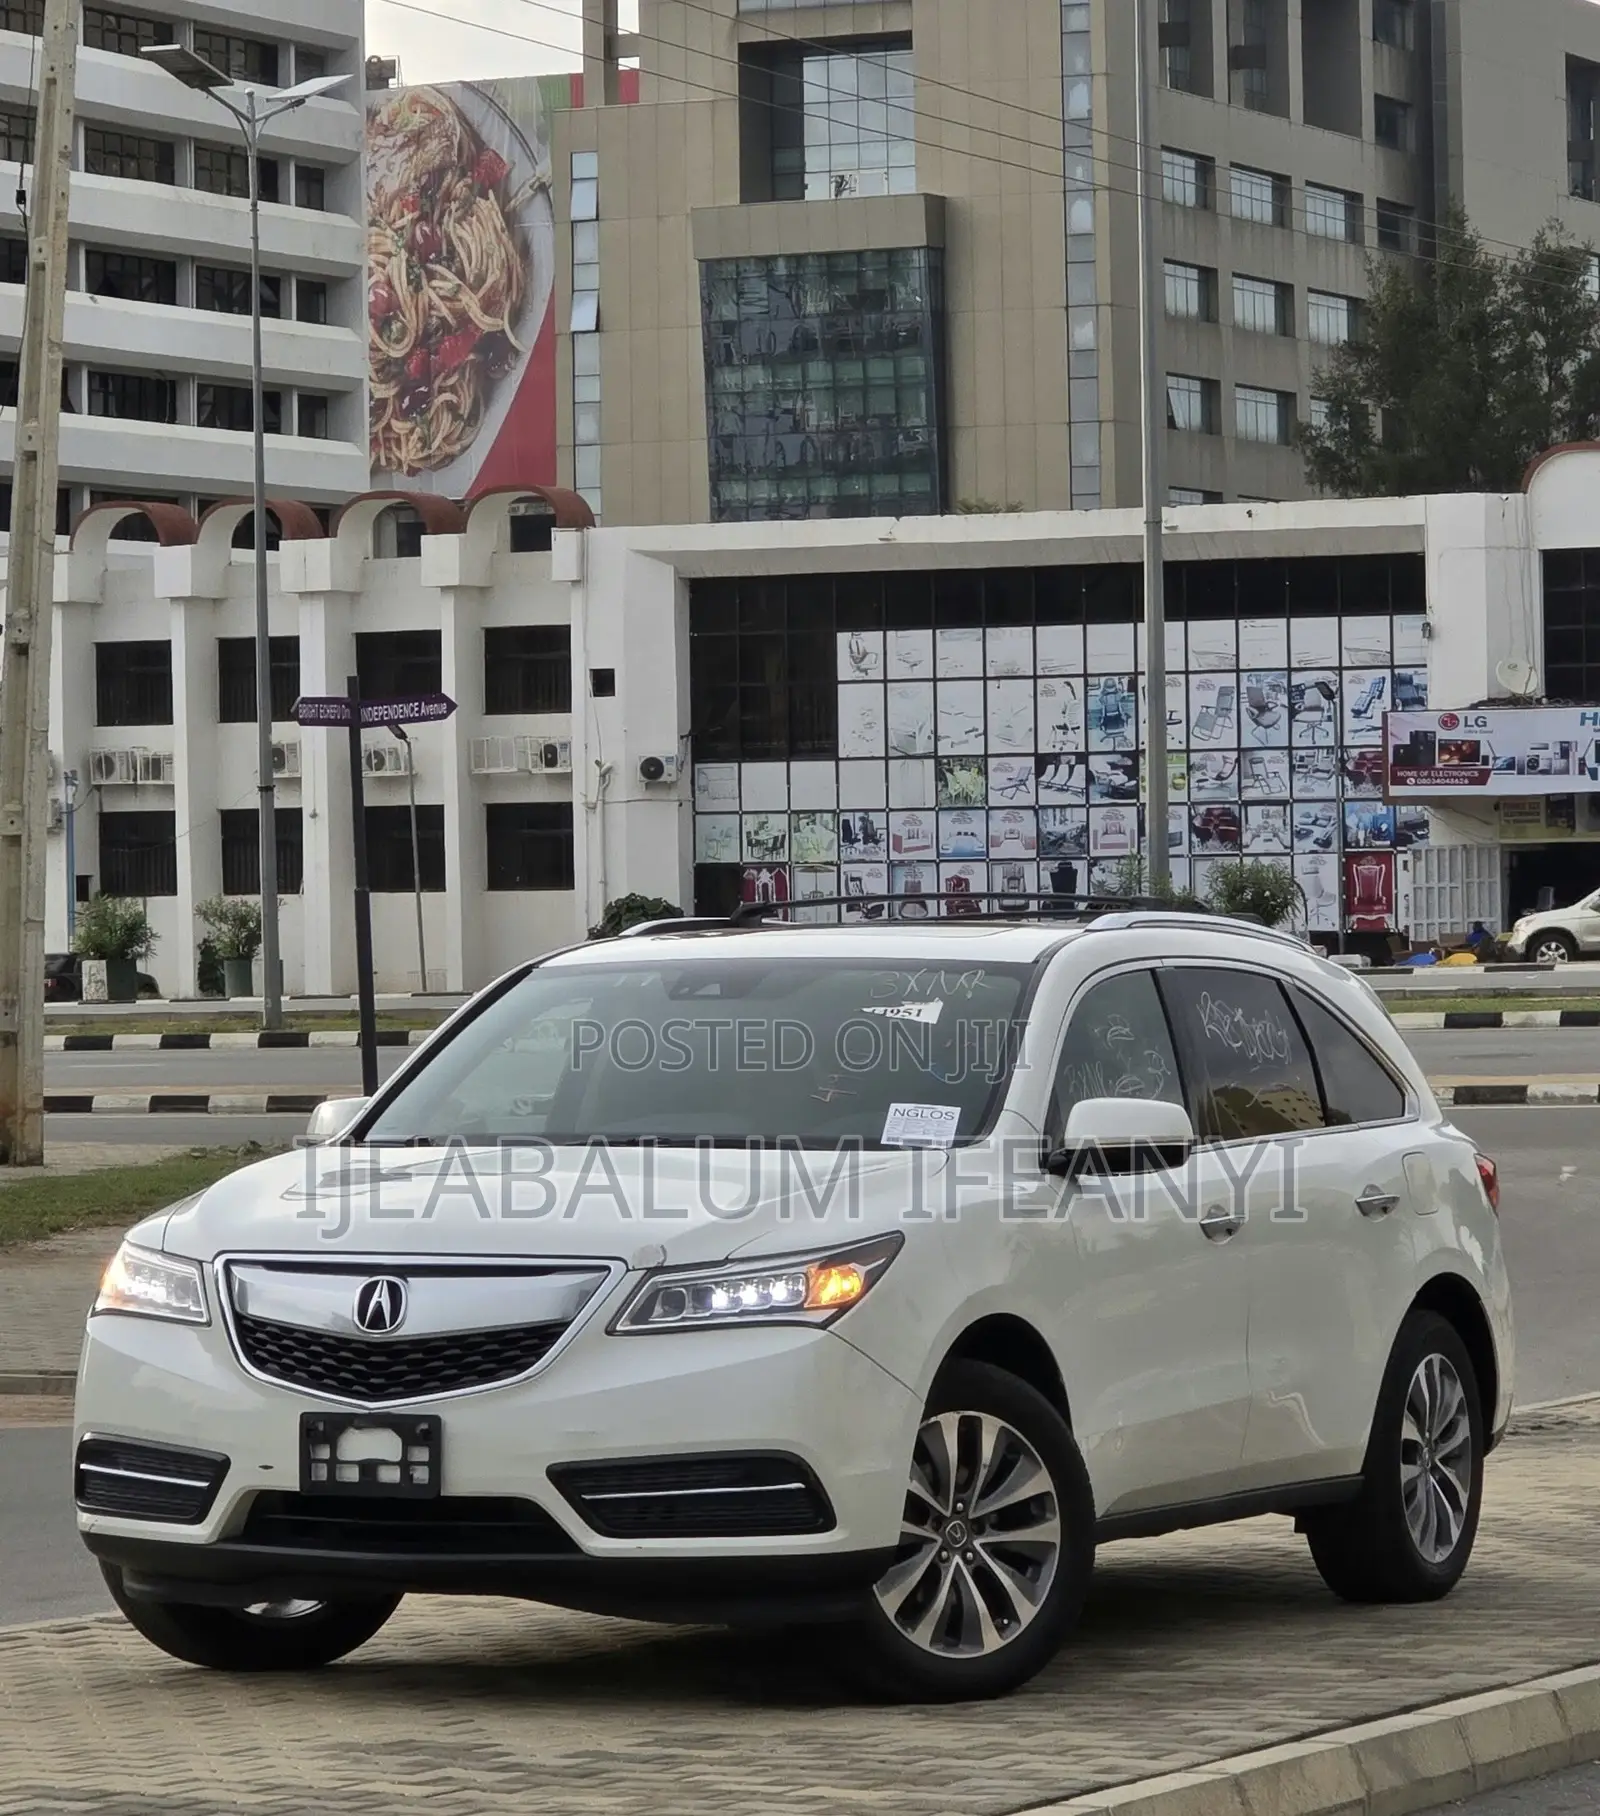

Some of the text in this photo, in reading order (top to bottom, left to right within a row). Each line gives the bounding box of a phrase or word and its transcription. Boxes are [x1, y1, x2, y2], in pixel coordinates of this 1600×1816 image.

[360, 701, 447, 722] INDEPENDENCE Avenue
[1463, 715, 1488, 728] LG
[1397, 770, 1418, 778] HOME
[892, 1107, 956, 1122] NGLOS
